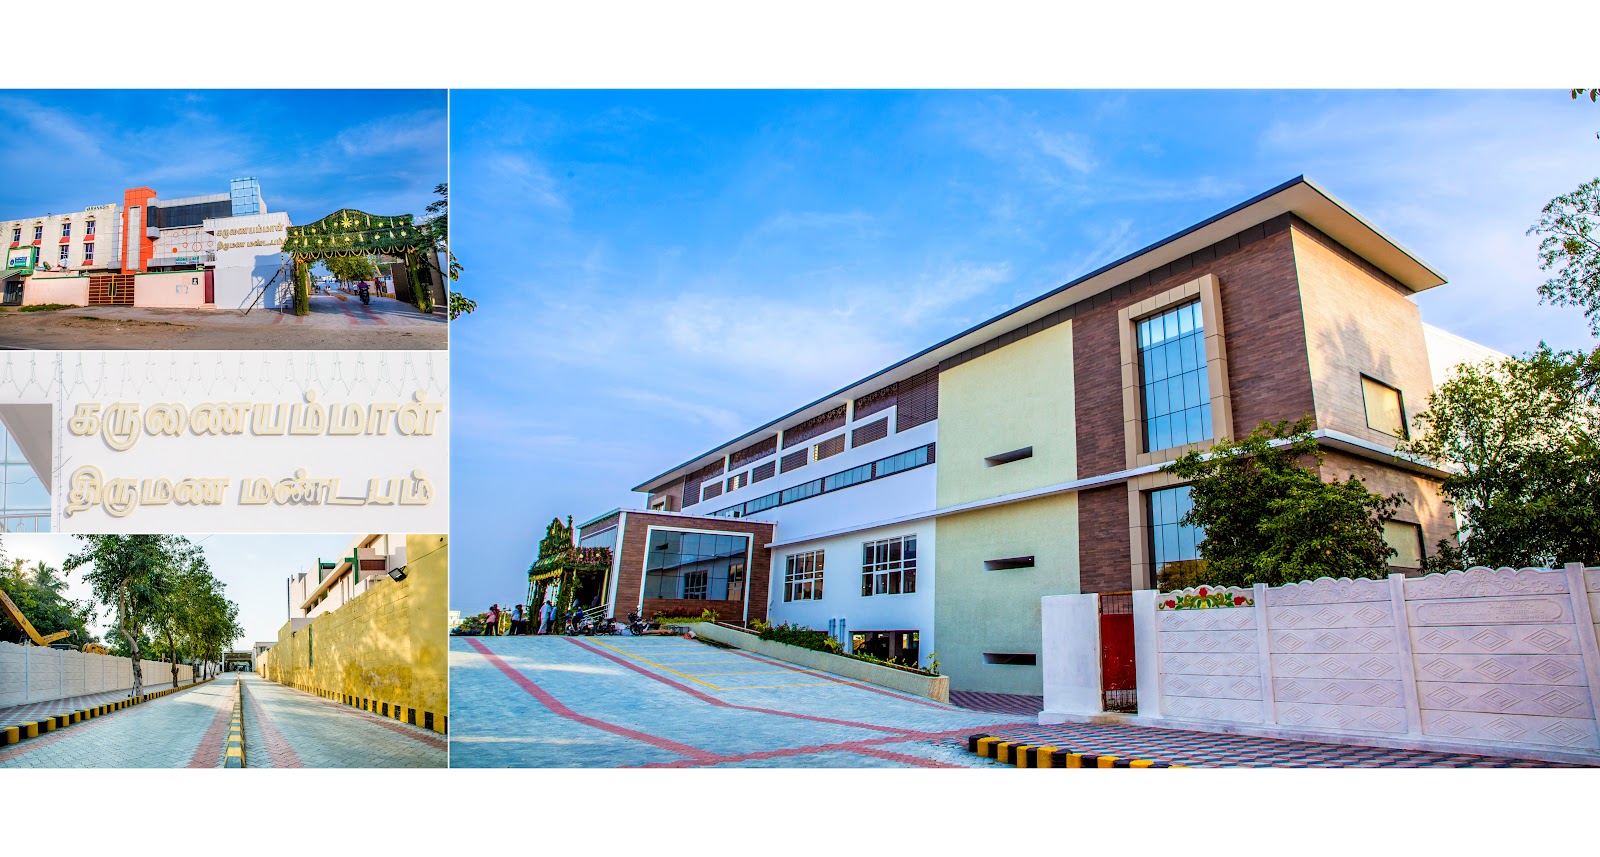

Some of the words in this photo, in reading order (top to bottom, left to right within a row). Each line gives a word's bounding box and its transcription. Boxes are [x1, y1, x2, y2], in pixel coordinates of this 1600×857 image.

[69, 389, 442, 451] கருணையம்மாள்
[66, 465, 230, 517] திருமண
[238, 468, 435, 506] மண்டபம்
